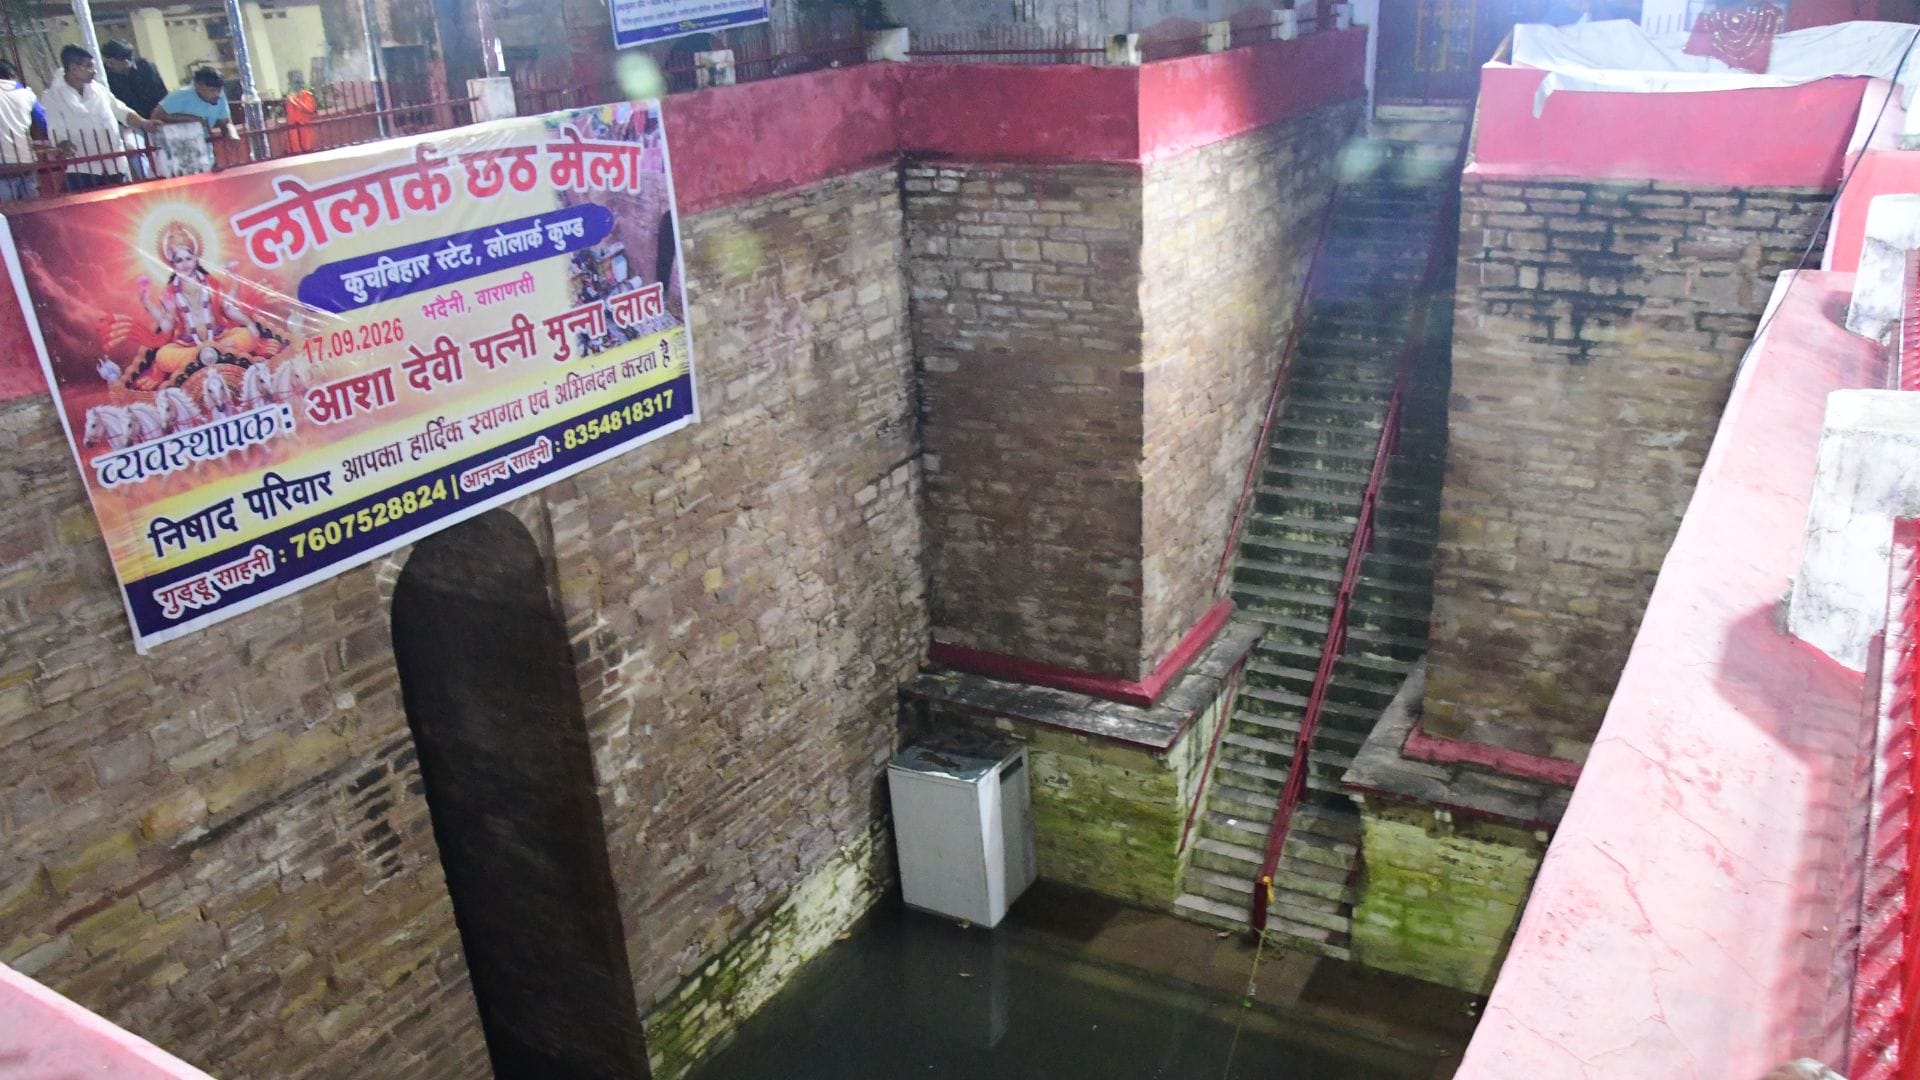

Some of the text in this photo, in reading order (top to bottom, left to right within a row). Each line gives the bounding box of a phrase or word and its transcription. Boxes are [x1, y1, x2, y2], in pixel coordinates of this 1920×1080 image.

[235, 127, 641, 265] लोलार्क छठ मेला
[340, 254, 431, 303] कुचबिहार
[484, 219, 543, 259] लोलार्क
[546, 216, 585, 250] कुण्ड
[303, 318, 404, 364] 17.09.2026
[308, 367, 395, 423] आशा
[402, 335, 462, 391] देवी
[470, 313, 537, 369] पत्नी
[543, 302, 605, 361] मुन्ना
[611, 285, 663, 326] लाल
[475, 271, 536, 305] वाराणसी
[147, 338, 671, 557] निषाद परिवार आपका हार्दिक स्वागत एवं अभिनंदन करता है
[214, 548, 271, 587] साहनी
[289, 478, 447, 558] 7607528824
[462, 460, 506, 489] आनन्द
[510, 440, 549, 470] साहनी
[563, 389, 674, 450] 8354818317
